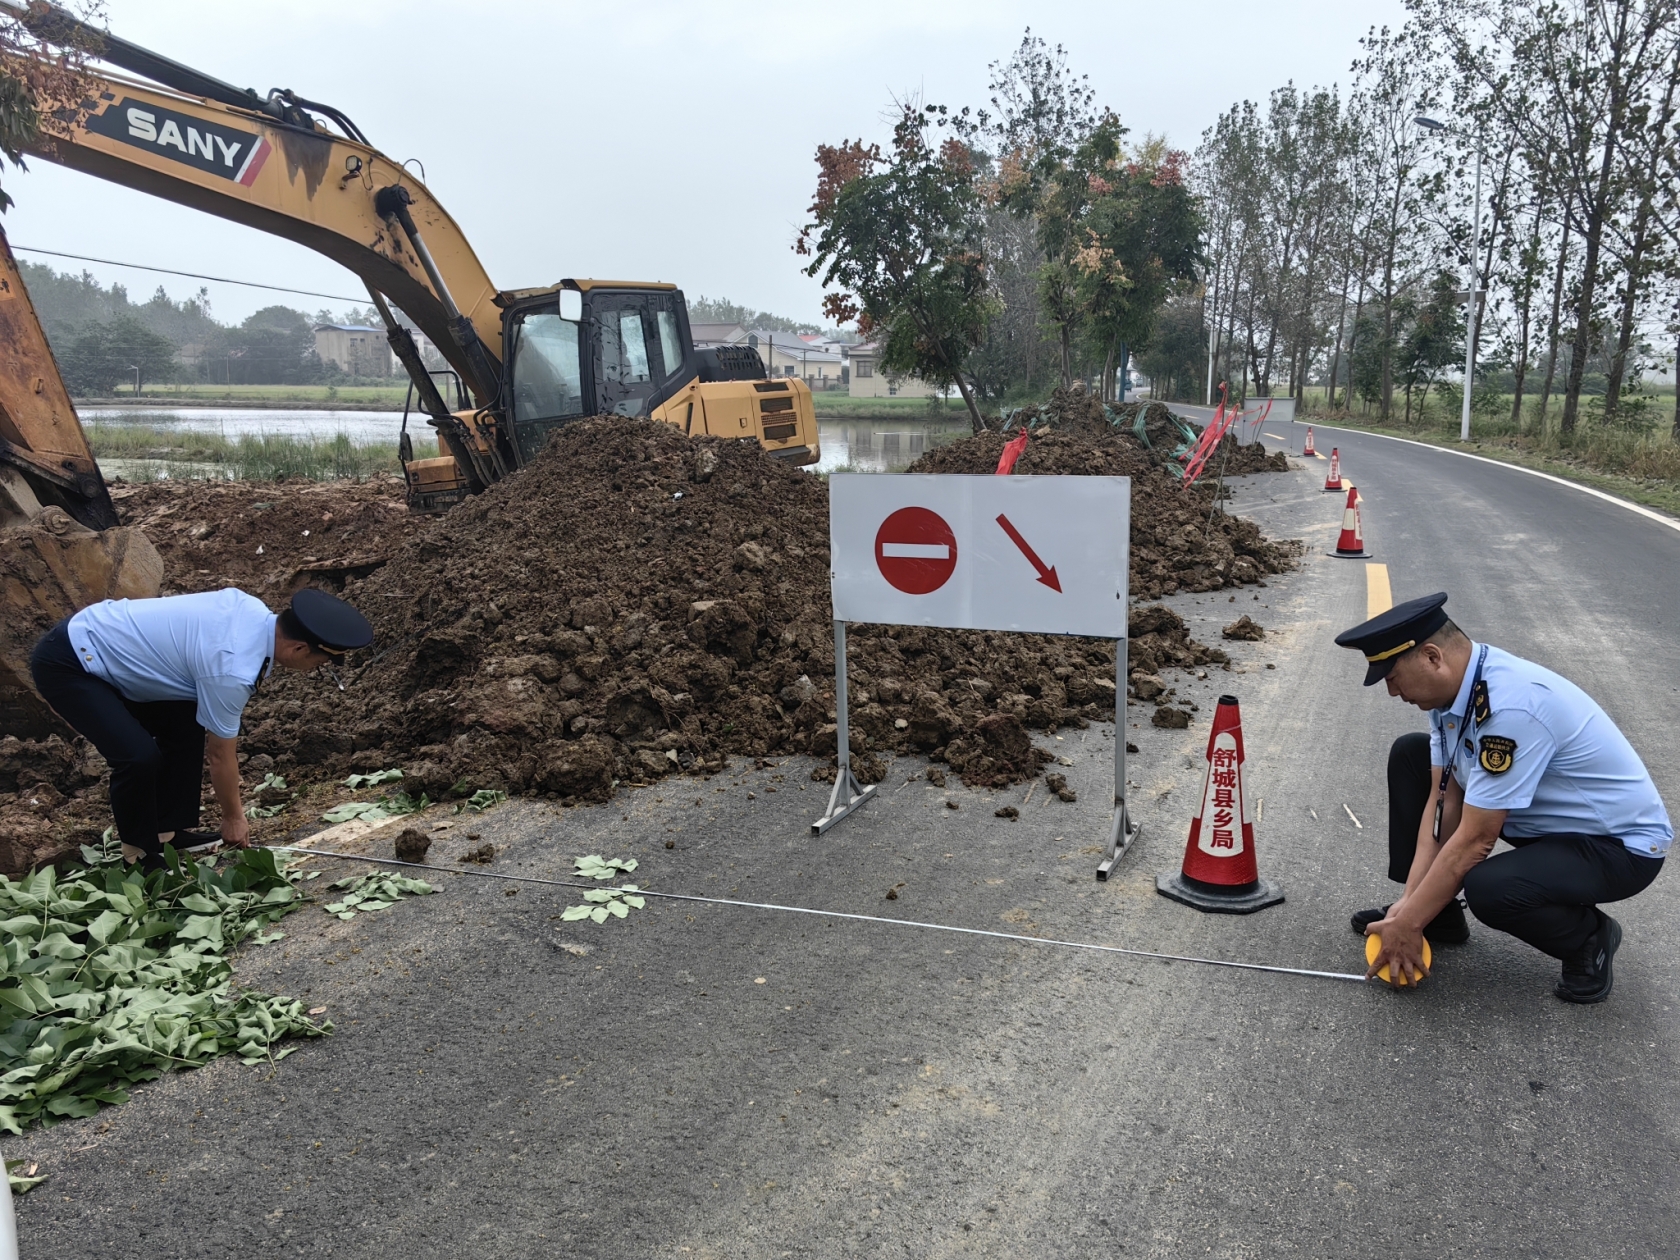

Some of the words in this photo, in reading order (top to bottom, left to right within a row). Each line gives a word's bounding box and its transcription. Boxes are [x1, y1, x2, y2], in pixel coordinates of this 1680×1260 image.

[127, 107, 242, 168] SANY
[1211, 747, 1237, 850] 舒城县乡局
